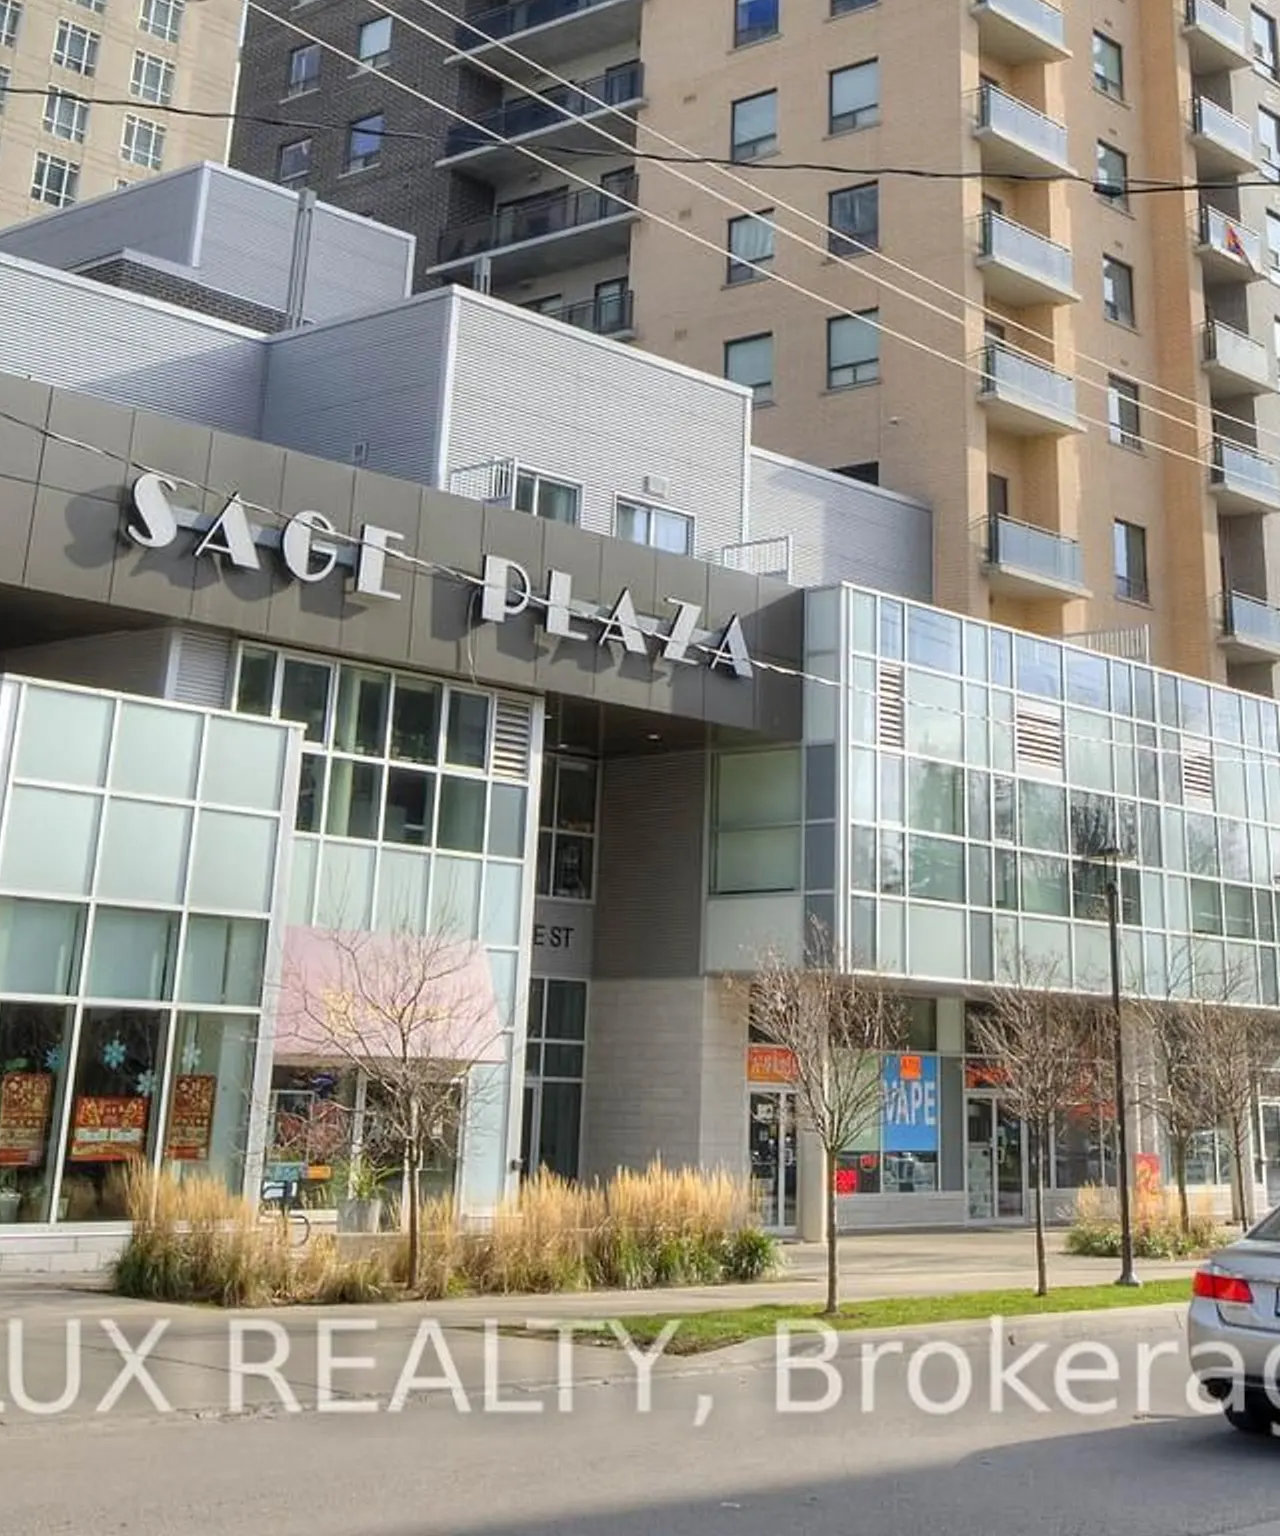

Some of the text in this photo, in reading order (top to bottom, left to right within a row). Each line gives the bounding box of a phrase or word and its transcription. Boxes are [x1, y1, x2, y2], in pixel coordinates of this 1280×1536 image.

[127, 472, 754, 680] SAGE PLAZA
[550, 926, 575, 947] ST
[881, 1079, 936, 1126] VAPE
